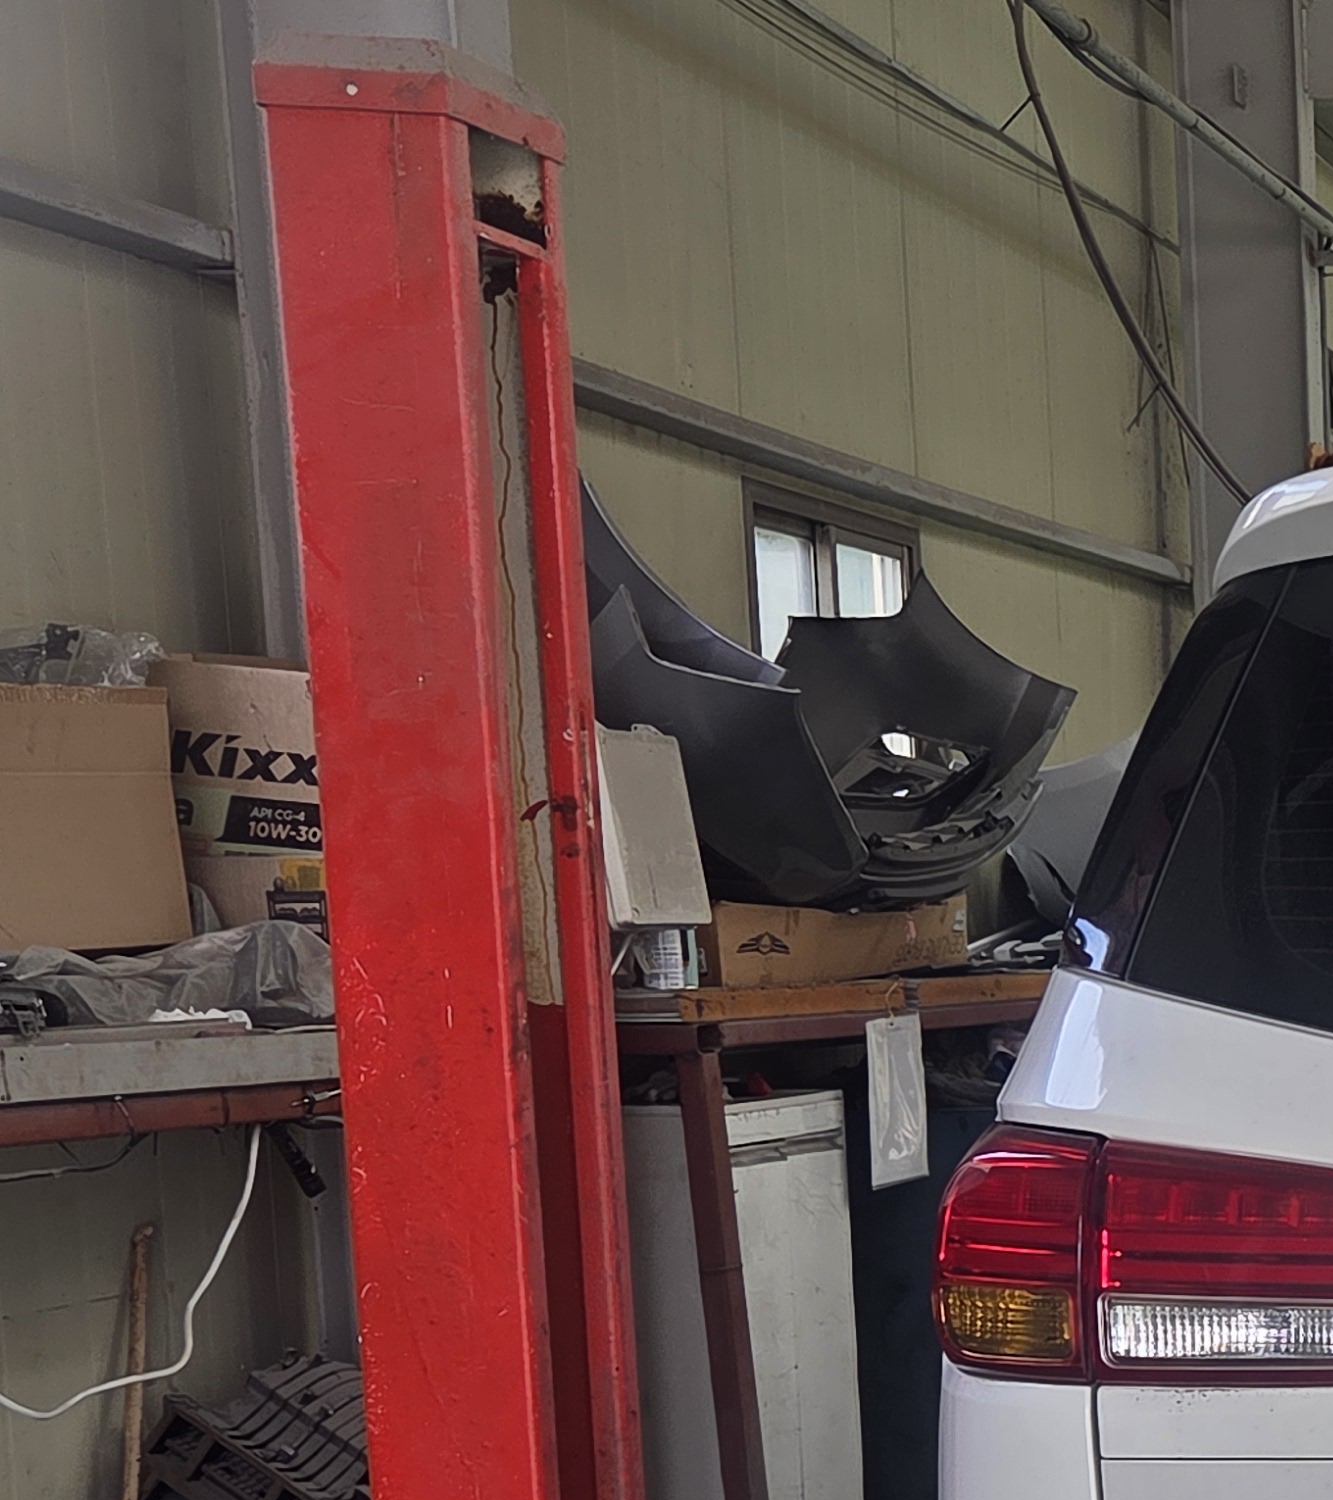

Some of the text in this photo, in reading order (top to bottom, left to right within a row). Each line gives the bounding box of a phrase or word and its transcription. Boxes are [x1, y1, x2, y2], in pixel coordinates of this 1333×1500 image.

[171, 729, 320, 786] Kixx
[250, 806, 272, 819] API
[248, 821, 323, 843] 10W-30
